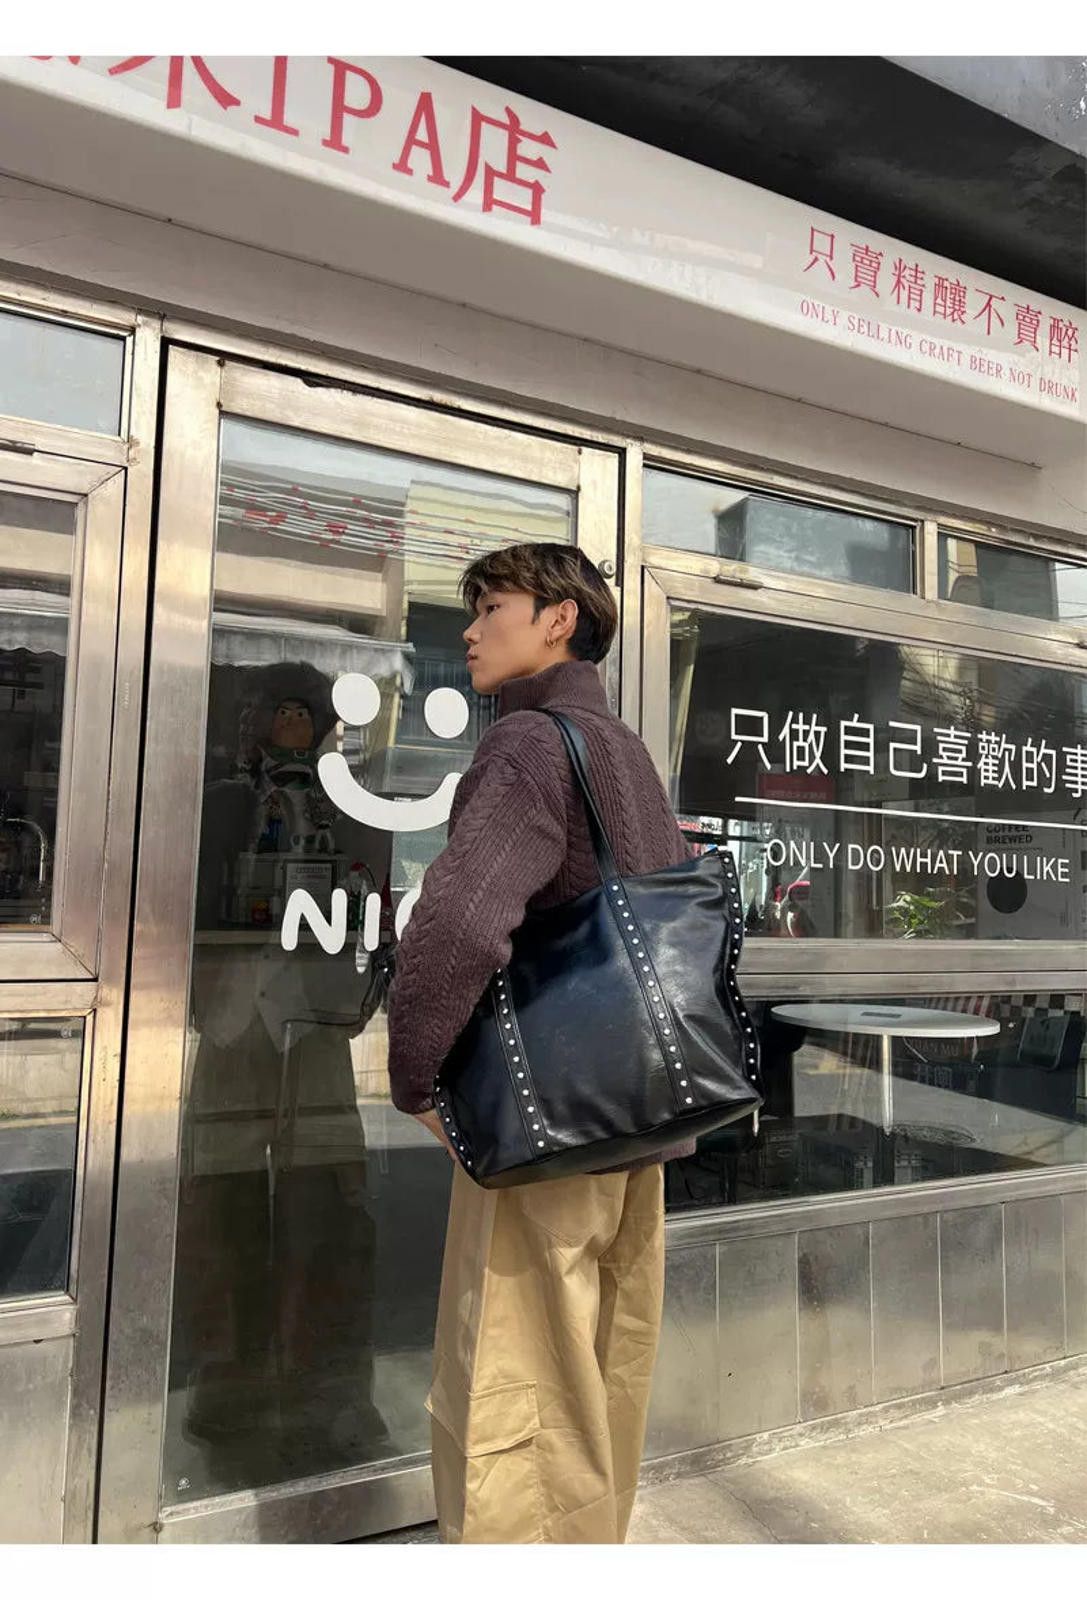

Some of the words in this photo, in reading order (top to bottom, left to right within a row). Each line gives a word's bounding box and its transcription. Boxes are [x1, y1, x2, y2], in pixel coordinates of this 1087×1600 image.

[803, 225, 1079, 363] 只賣精釀不賣醉
[800, 299, 840, 326] ONLY
[847, 316, 913, 350] SELLING
[919, 339, 964, 366] CRAFT
[969, 355, 1004, 379] BEER
[1008, 367, 1033, 388] NOT
[1038, 377, 1078, 403] DRUNK
[726, 707, 1087, 798] 只做自己喜歡的事
[766, 838, 840, 870] ONLY
[847, 844, 885, 872] DO
[891, 847, 963, 876] WHAT
[968, 850, 1017, 878] YOU
[1023, 855, 1070, 883] LIKE
[986, 834, 1033, 845] BREWED
